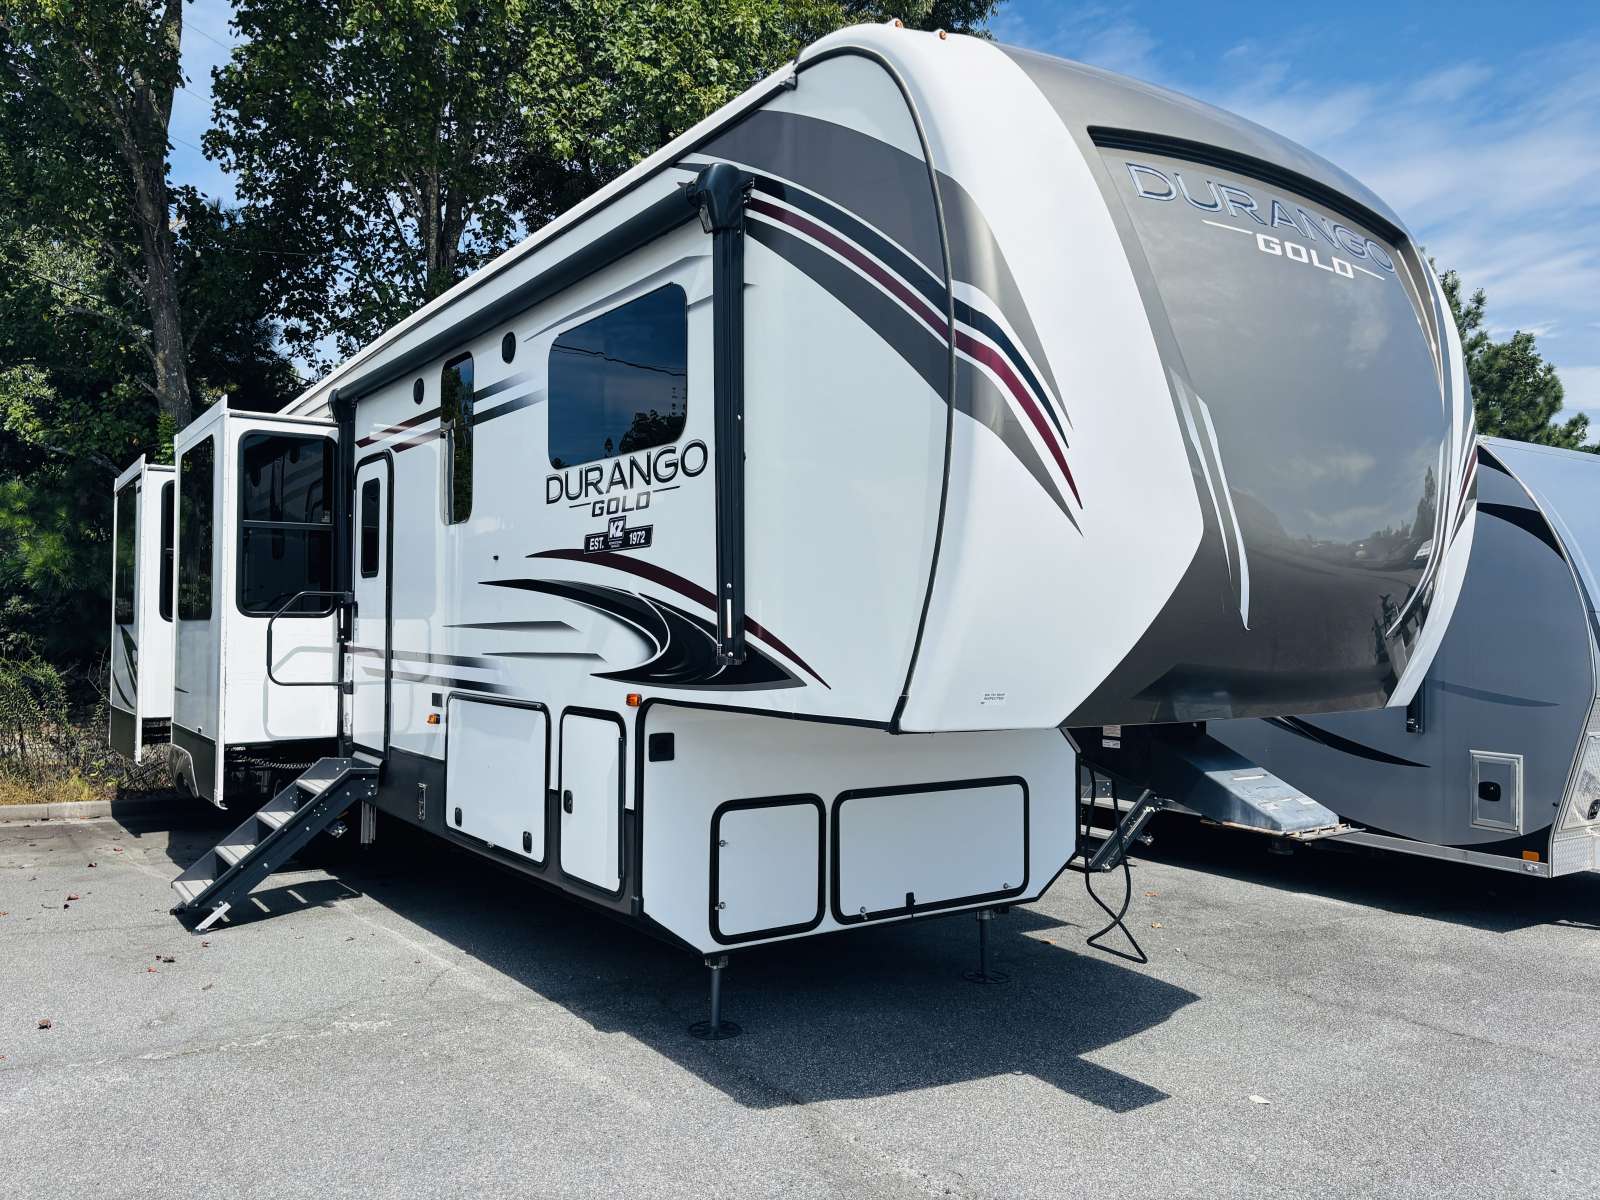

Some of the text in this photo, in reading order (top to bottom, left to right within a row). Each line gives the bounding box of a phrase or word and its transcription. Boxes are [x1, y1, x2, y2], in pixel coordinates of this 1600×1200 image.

[1125, 162, 1396, 273] DURANGO
[1256, 233, 1354, 279] GOLD
[546, 439, 708, 504] DURANGO
[591, 491, 651, 518] GOLD
[589, 537, 604, 550] EST.
[629, 531, 646, 545] 1972
[609, 521, 624, 538] KZ
